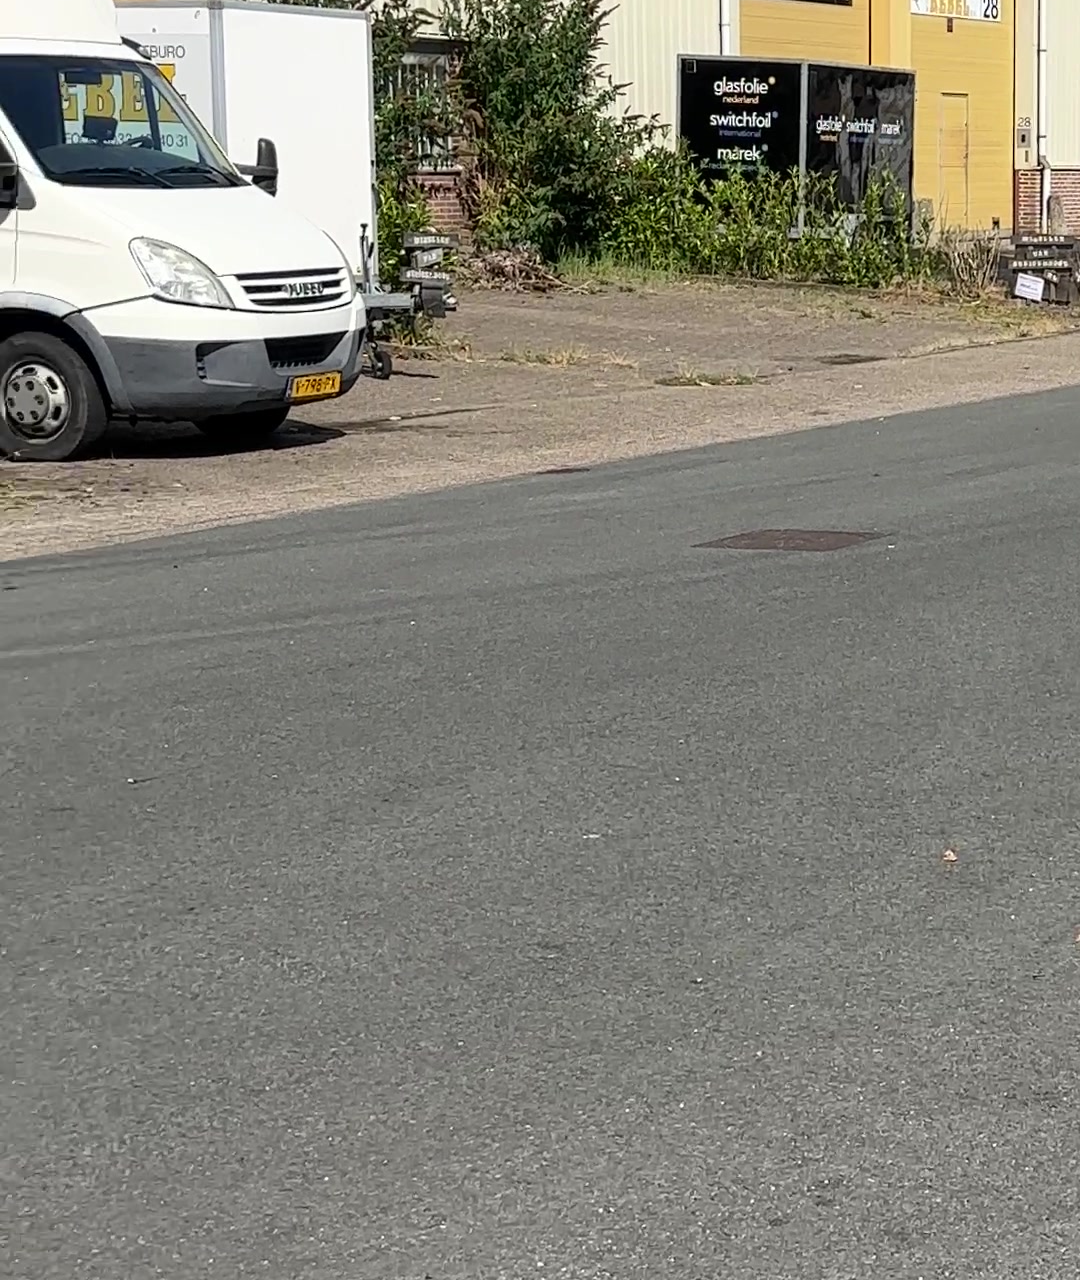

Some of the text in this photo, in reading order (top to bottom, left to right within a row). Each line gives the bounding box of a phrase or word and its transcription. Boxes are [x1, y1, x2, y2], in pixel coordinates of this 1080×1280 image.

[713, 76, 769, 96] glasfolie
[722, 95, 759, 104] nederland
[709, 111, 772, 128] switchfoil
[1017, 116, 1031, 127] 28
[717, 144, 761, 161] marek
